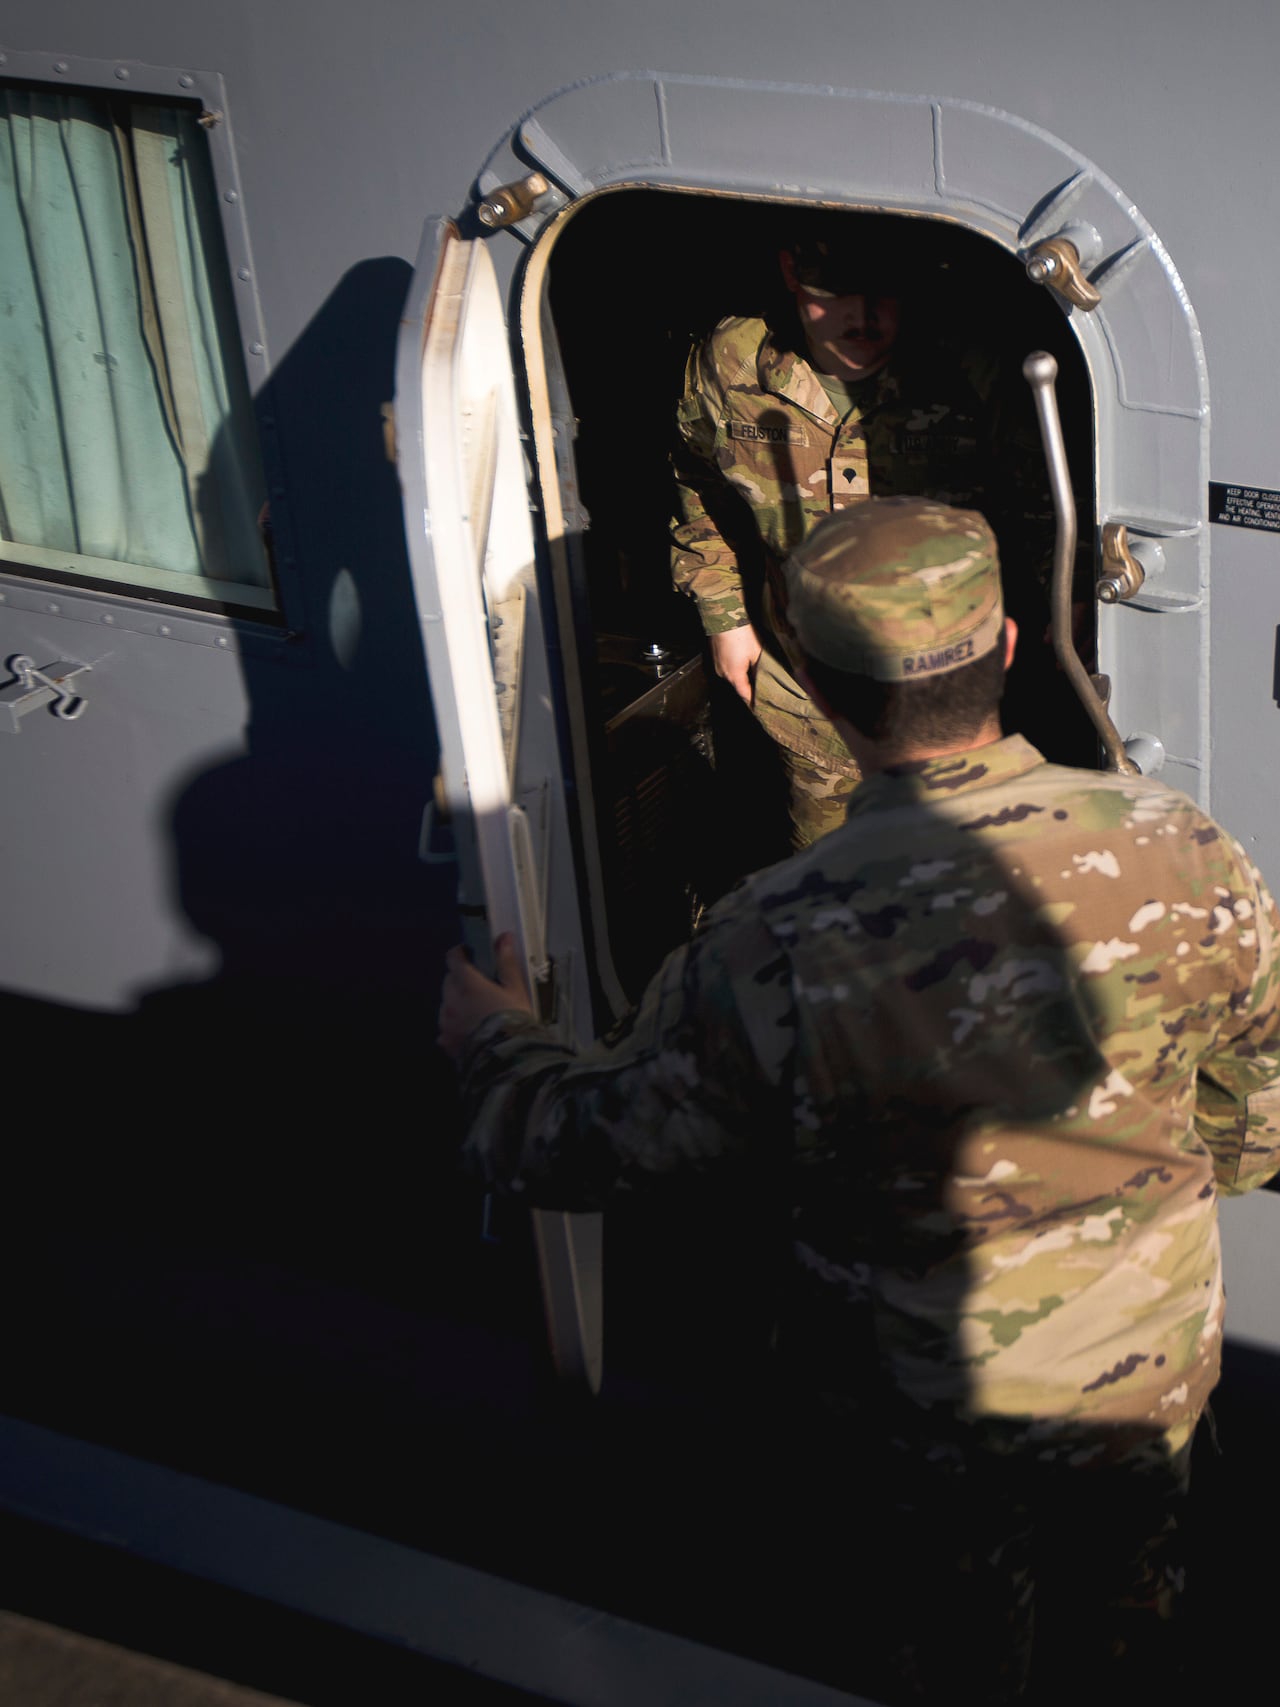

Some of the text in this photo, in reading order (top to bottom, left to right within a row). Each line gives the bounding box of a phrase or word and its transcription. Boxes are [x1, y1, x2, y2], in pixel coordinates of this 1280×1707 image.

[1226, 488, 1241, 496] KEEP
[1244, 490, 1259, 498] DOOR
[1226, 497, 1254, 509] EFFECTIVE
[1225, 505, 1235, 514] THE
[1218, 513, 1230, 521] AND
[1243, 516, 1280, 529] CONDITIONING
[903, 639, 974, 676] RAMIREZ
